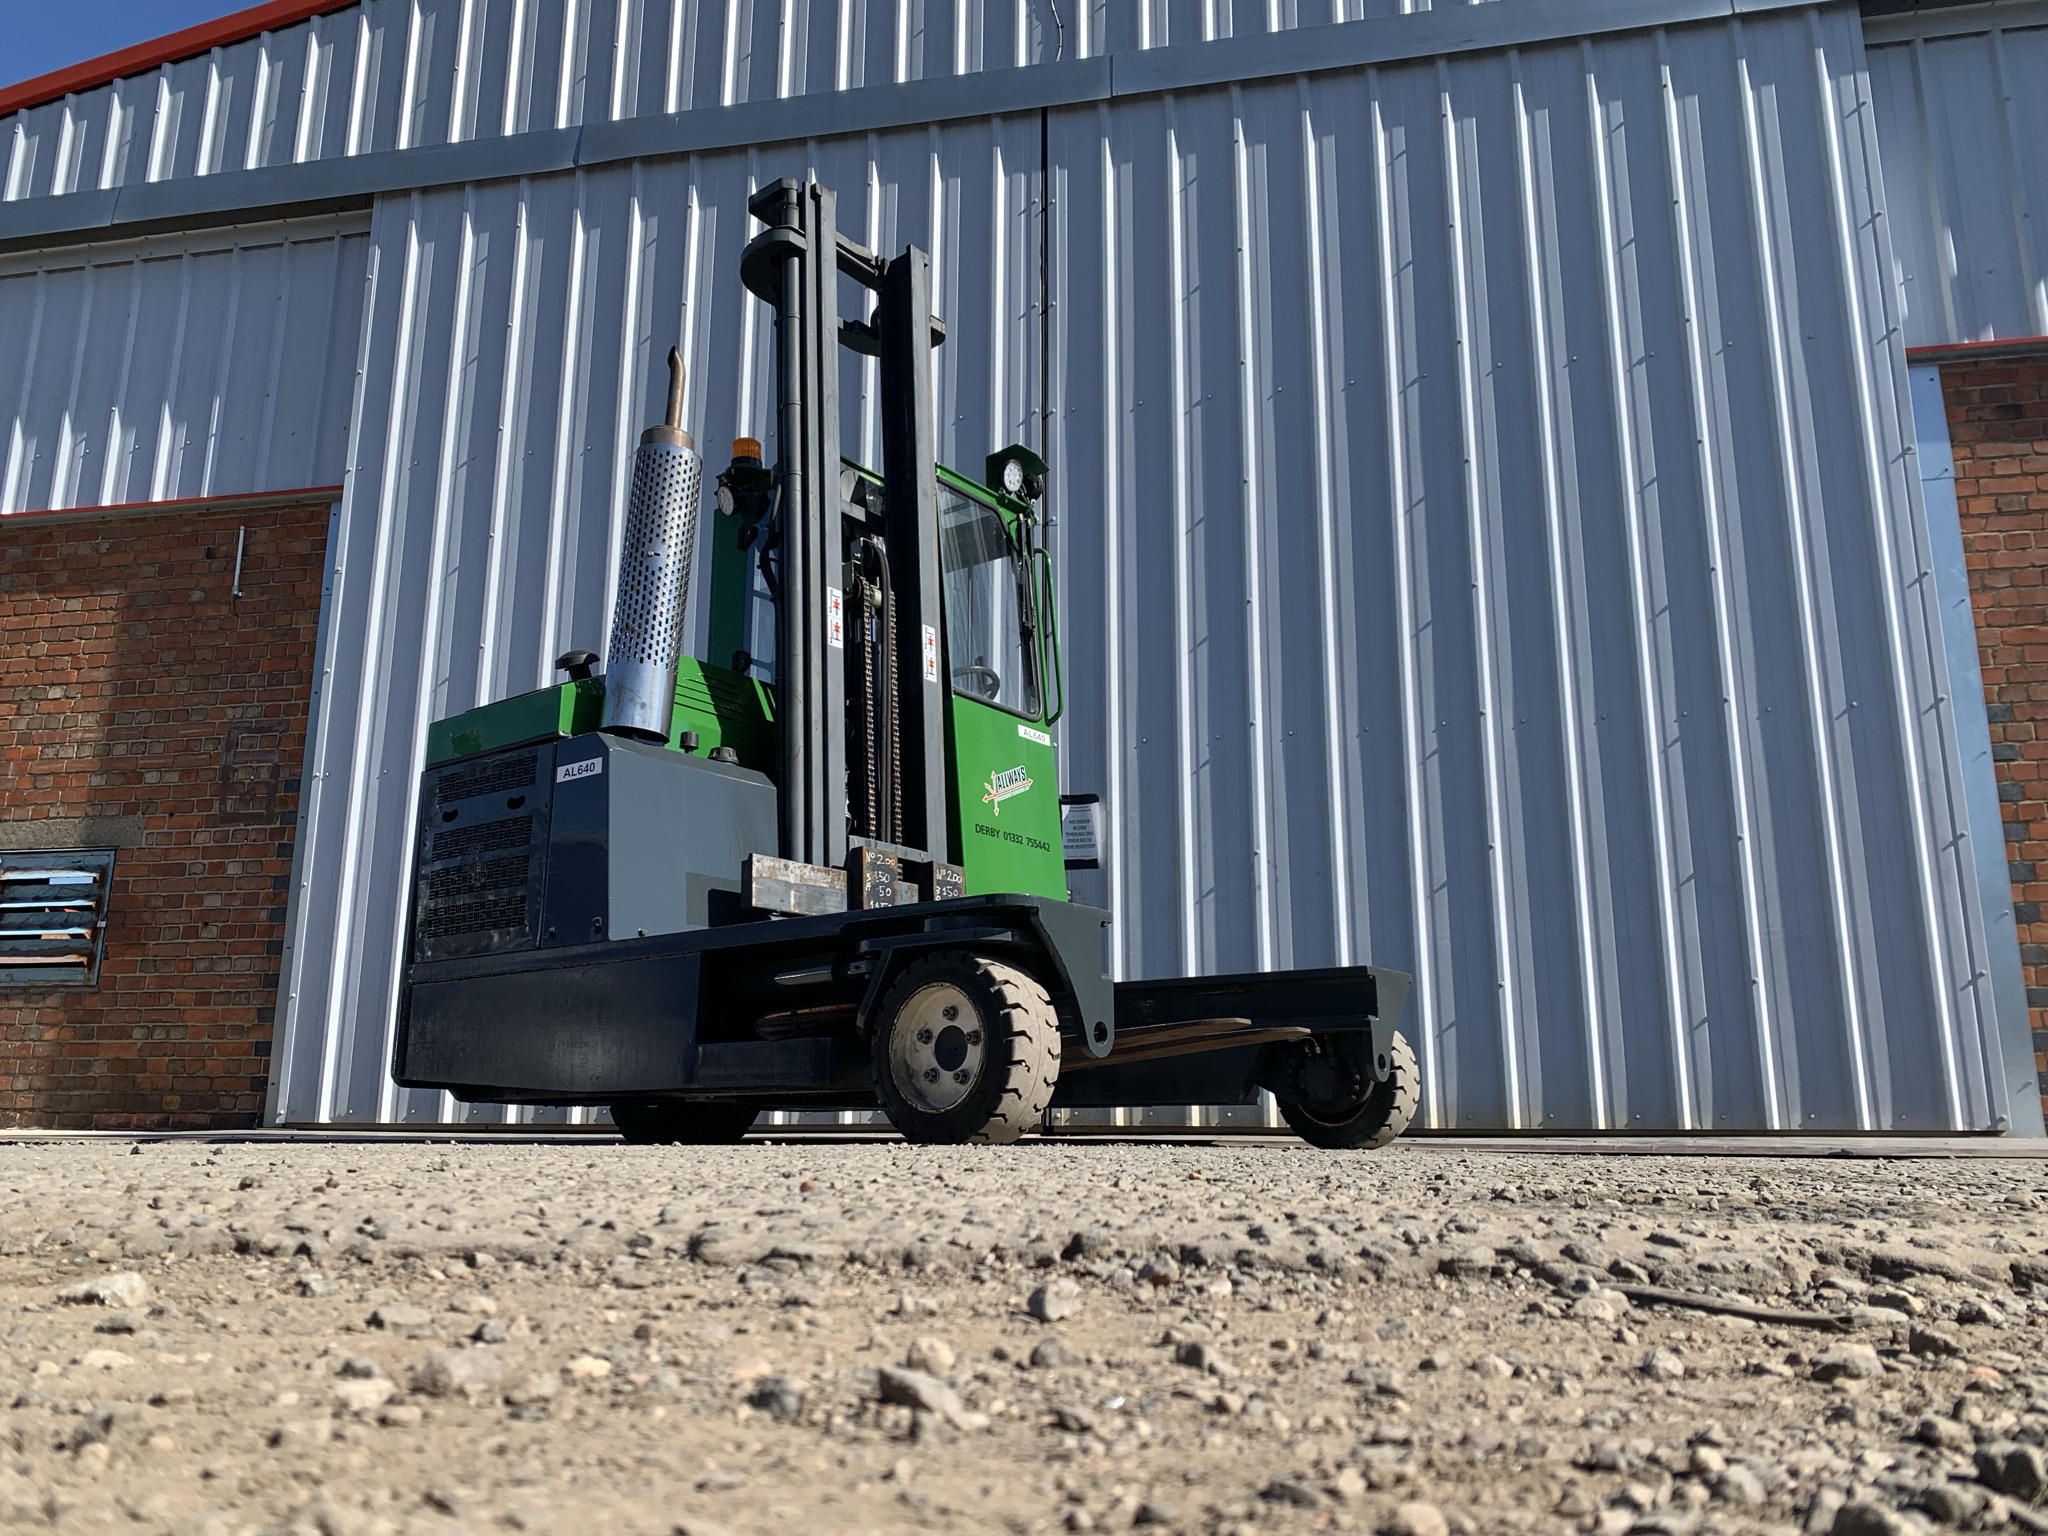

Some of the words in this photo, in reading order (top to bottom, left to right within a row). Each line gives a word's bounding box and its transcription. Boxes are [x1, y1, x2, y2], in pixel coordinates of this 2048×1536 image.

[1023, 728, 1046, 743] AL640
[562, 761, 596, 779] AL640
[997, 766, 1027, 791] ALLWAYS
[975, 823, 1001, 839] DERBY
[1003, 830, 1024, 845] 01332
[1025, 837, 1051, 853] 755442
[947, 870, 963, 884] 200
